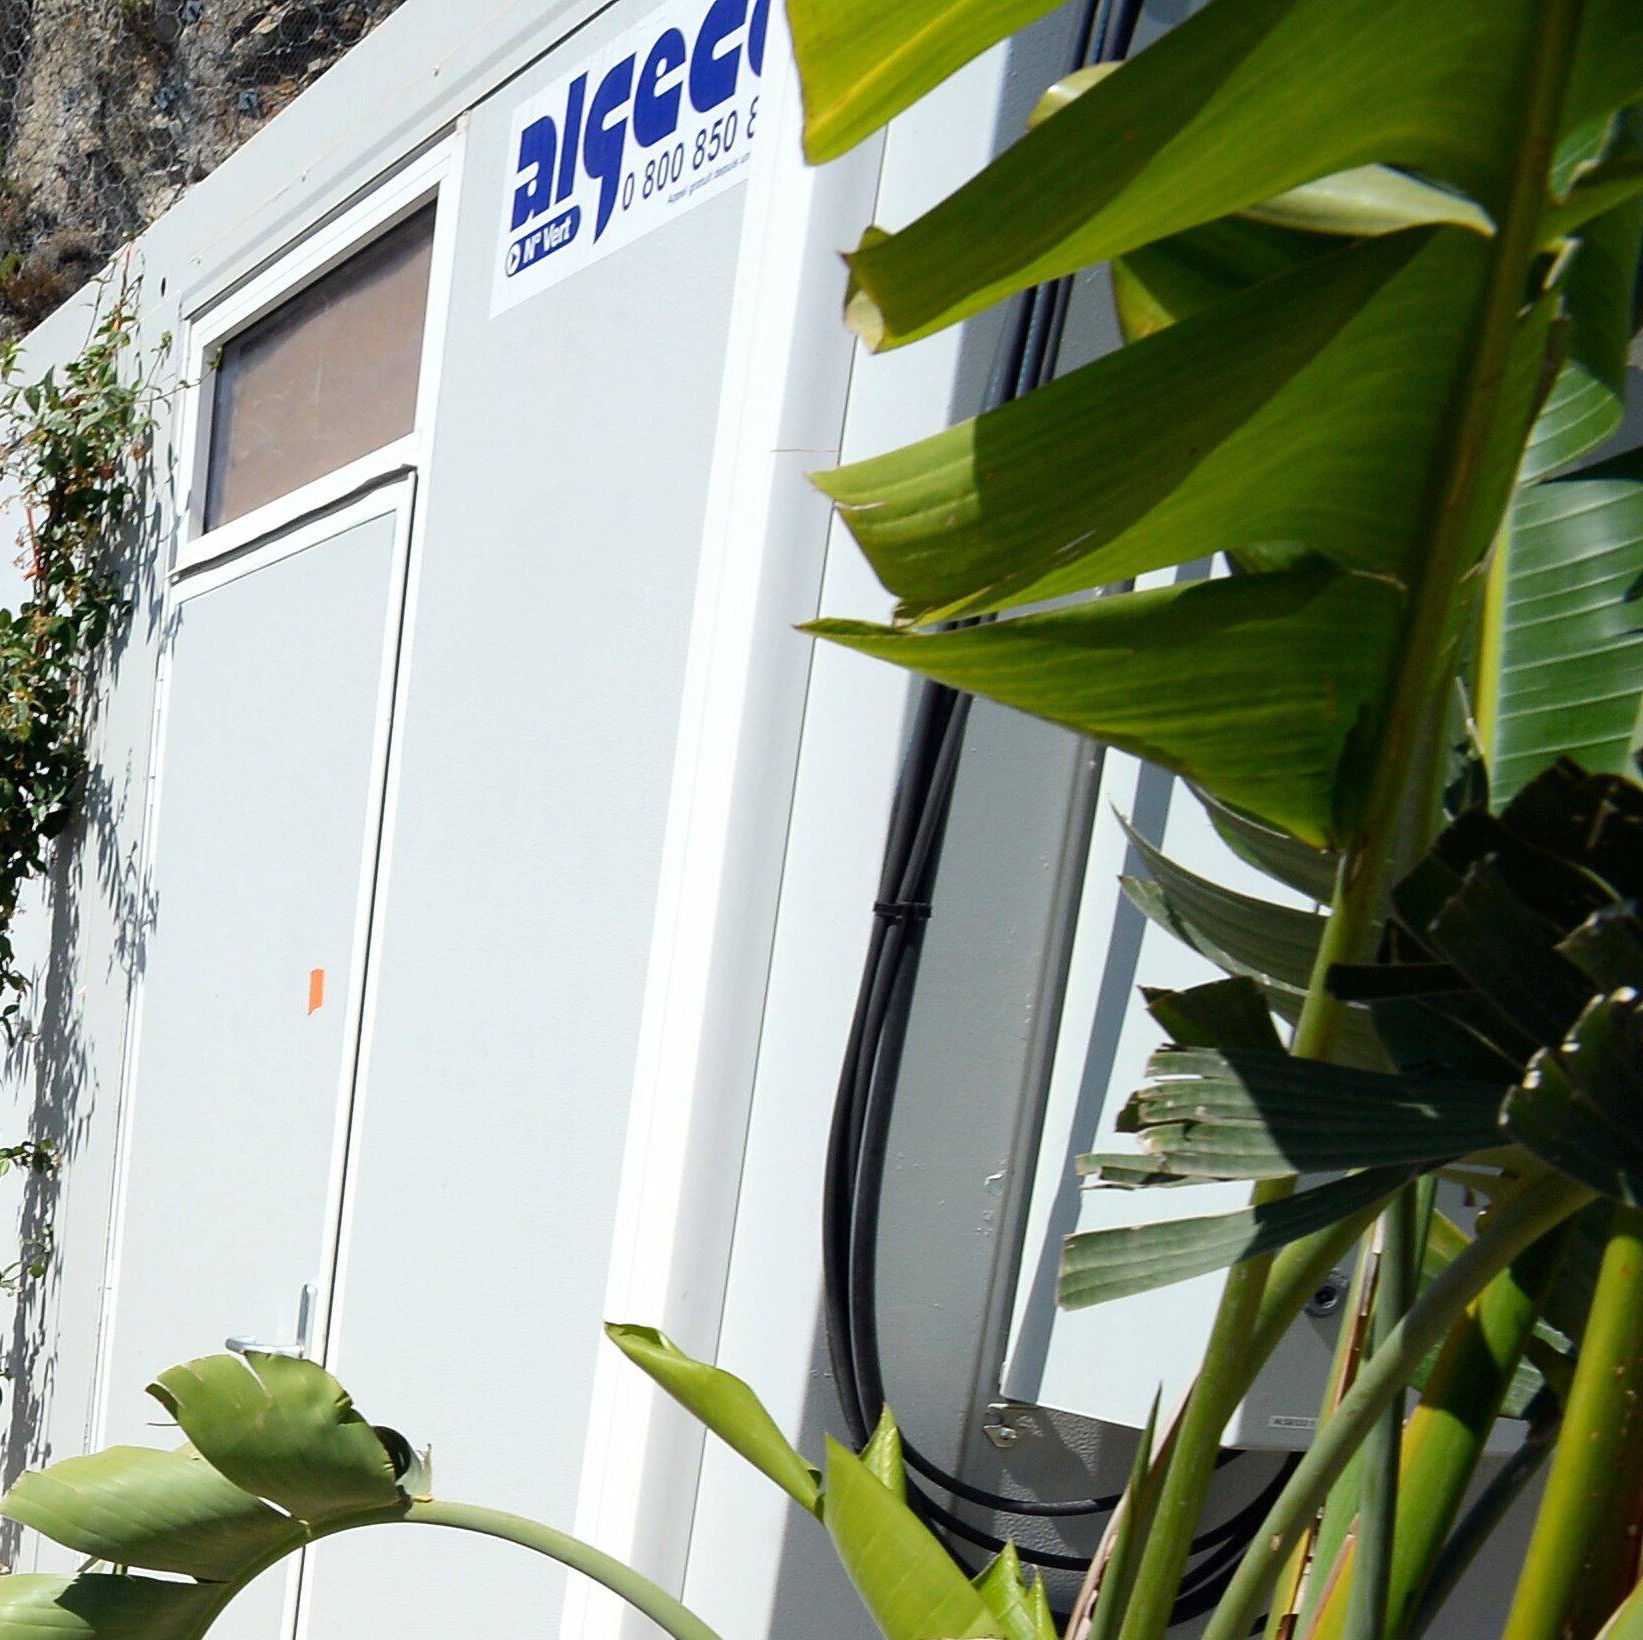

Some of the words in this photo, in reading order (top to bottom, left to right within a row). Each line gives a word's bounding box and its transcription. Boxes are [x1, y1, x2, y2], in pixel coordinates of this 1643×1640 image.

[622, 171, 635, 211] 0
[642, 141, 685, 200] 800
[692, 109, 738, 171] 850
